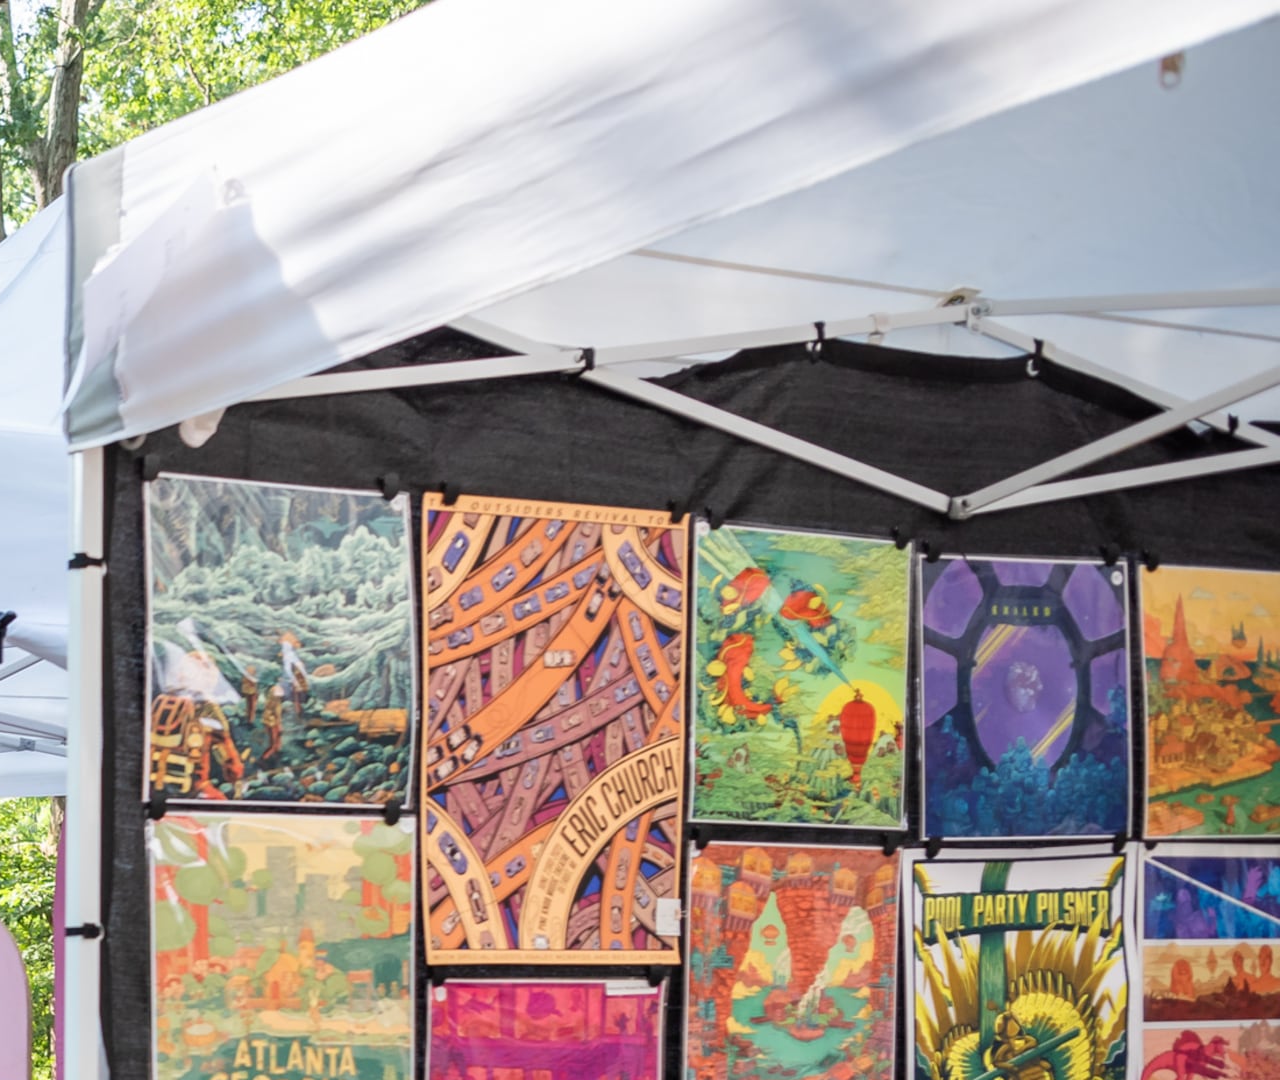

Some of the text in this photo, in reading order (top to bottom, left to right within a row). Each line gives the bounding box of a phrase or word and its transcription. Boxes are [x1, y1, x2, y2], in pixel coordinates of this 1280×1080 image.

[470, 501, 565, 517] OUTSIDERS
[573, 509, 638, 524] REVIVAL
[560, 748, 678, 858] ERIC CHURCH
[924, 889, 1111, 939] POOL PARTY PILSNER
[233, 1038, 357, 1078] ATLANTA
